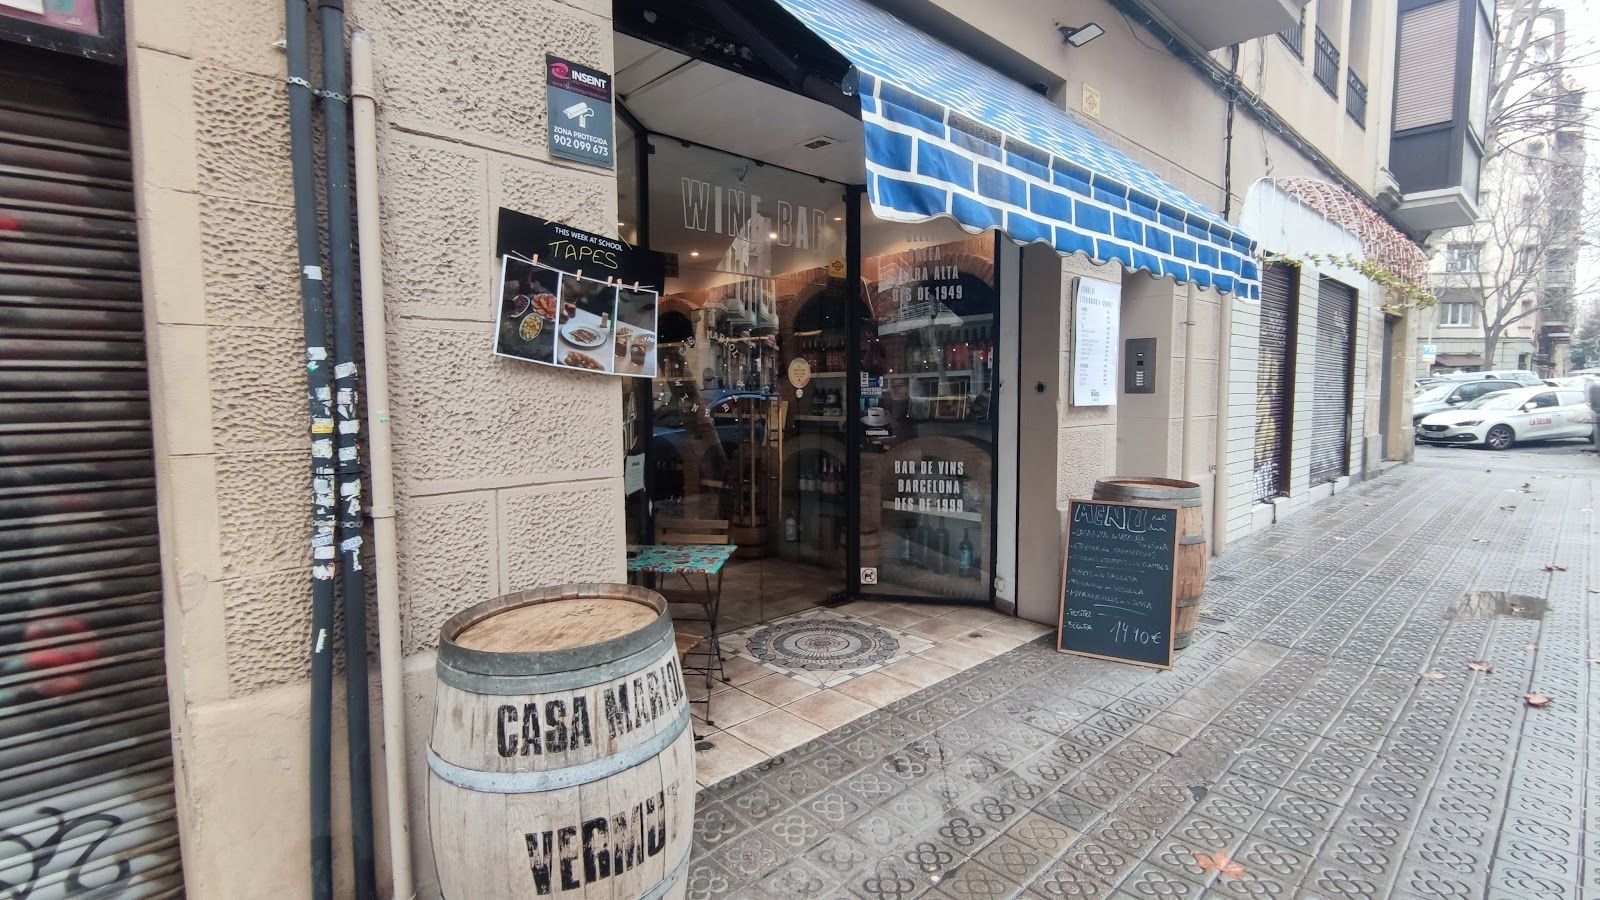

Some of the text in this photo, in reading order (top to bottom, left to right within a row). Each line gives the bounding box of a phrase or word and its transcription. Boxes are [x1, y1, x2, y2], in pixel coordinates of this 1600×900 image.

[571, 70, 606, 88] INSEINT
[553, 126, 608, 146] ZONA PROTEGIDA
[553, 135, 609, 156] 902 099 673
[555, 226, 623, 251] THIS WEEK AT SCHOOL
[548, 240, 618, 269] TAPES
[934, 265, 959, 280] ALTA
[917, 287, 930, 301] DE
[935, 285, 963, 300] 1949
[894, 460, 964, 476] BAR DE VINS
[898, 479, 960, 494] BARCELONA
[894, 498, 964, 512] DES DE 1999
[497, 656, 684, 758] CASA MARIOL
[525, 782, 680, 896] VERMUT
